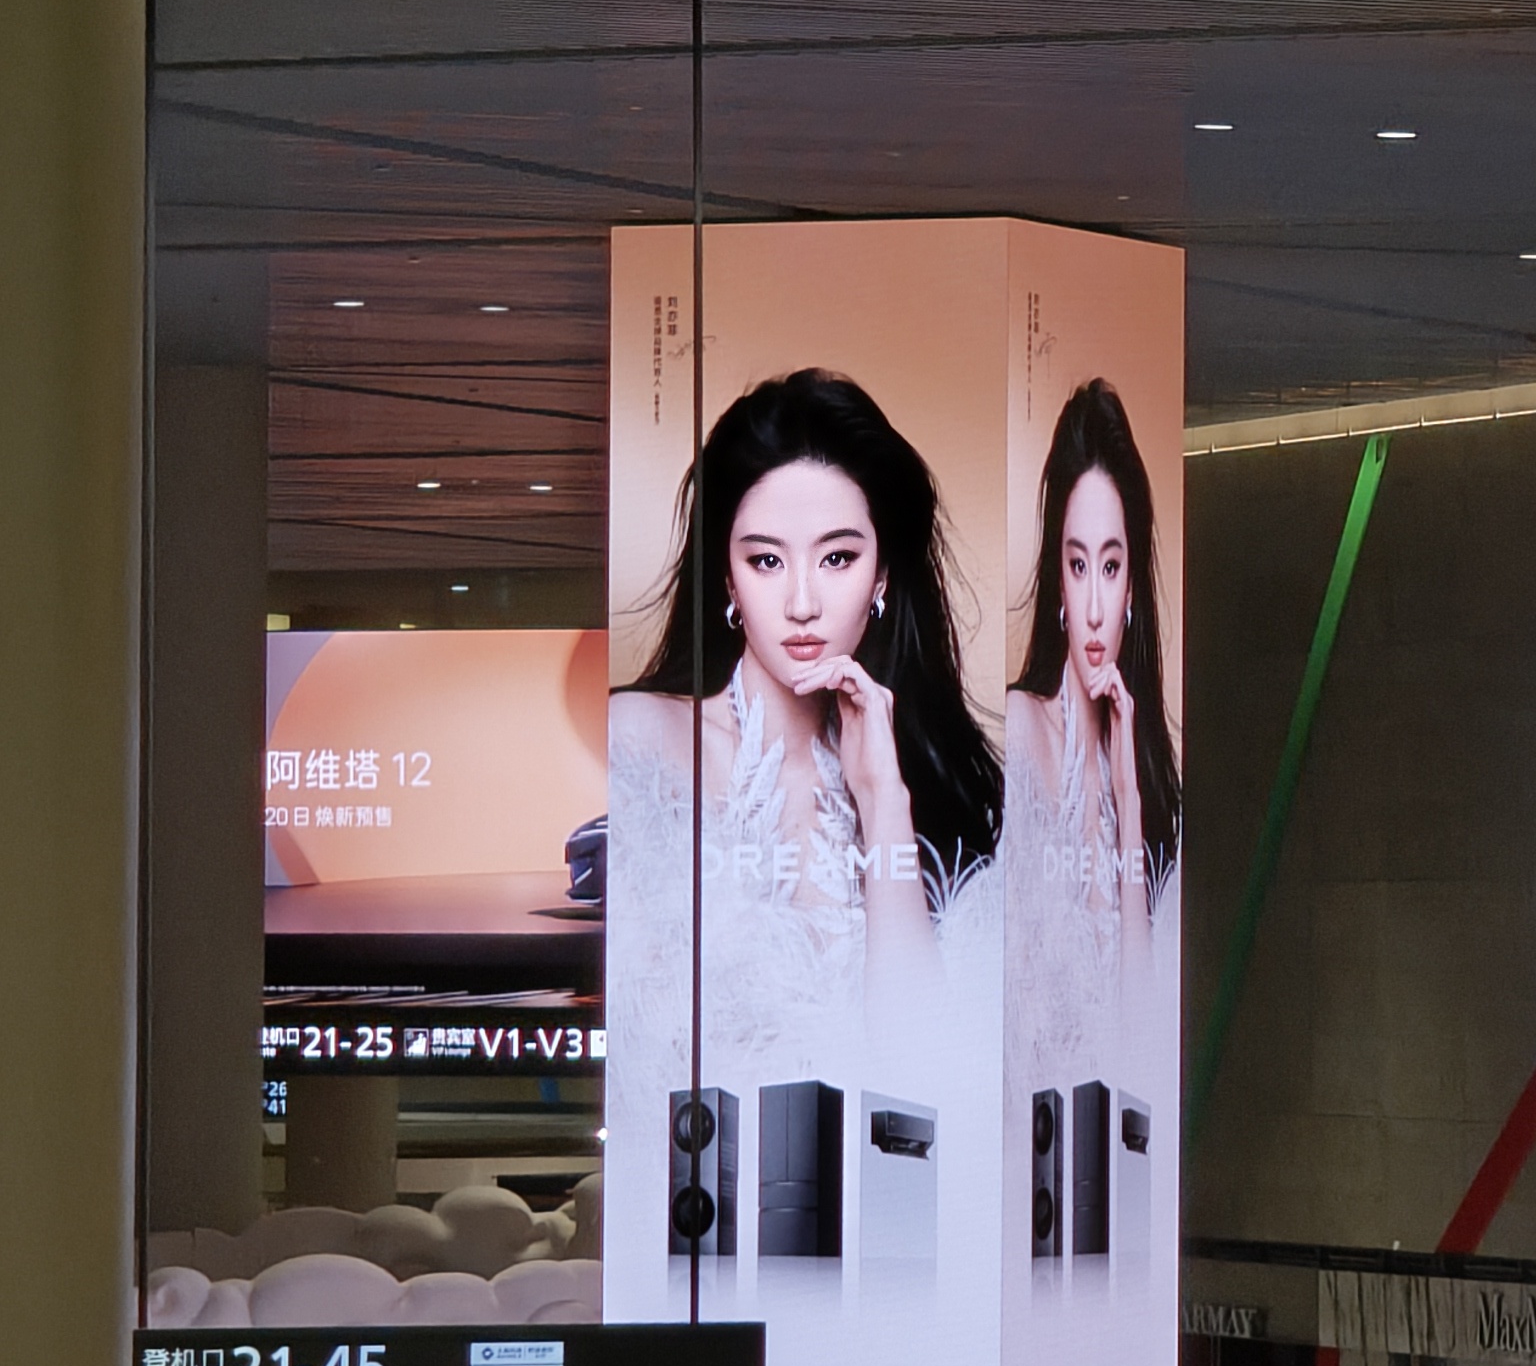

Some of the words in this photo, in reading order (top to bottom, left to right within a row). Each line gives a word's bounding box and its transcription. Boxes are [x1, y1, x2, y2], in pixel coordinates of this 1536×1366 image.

[266, 749, 380, 790] 阿维塔
[392, 751, 432, 786] 12
[294, 807, 309, 826] 日
[304, 1026, 393, 1059] 21-25
[478, 1027, 583, 1059] V1-V3
